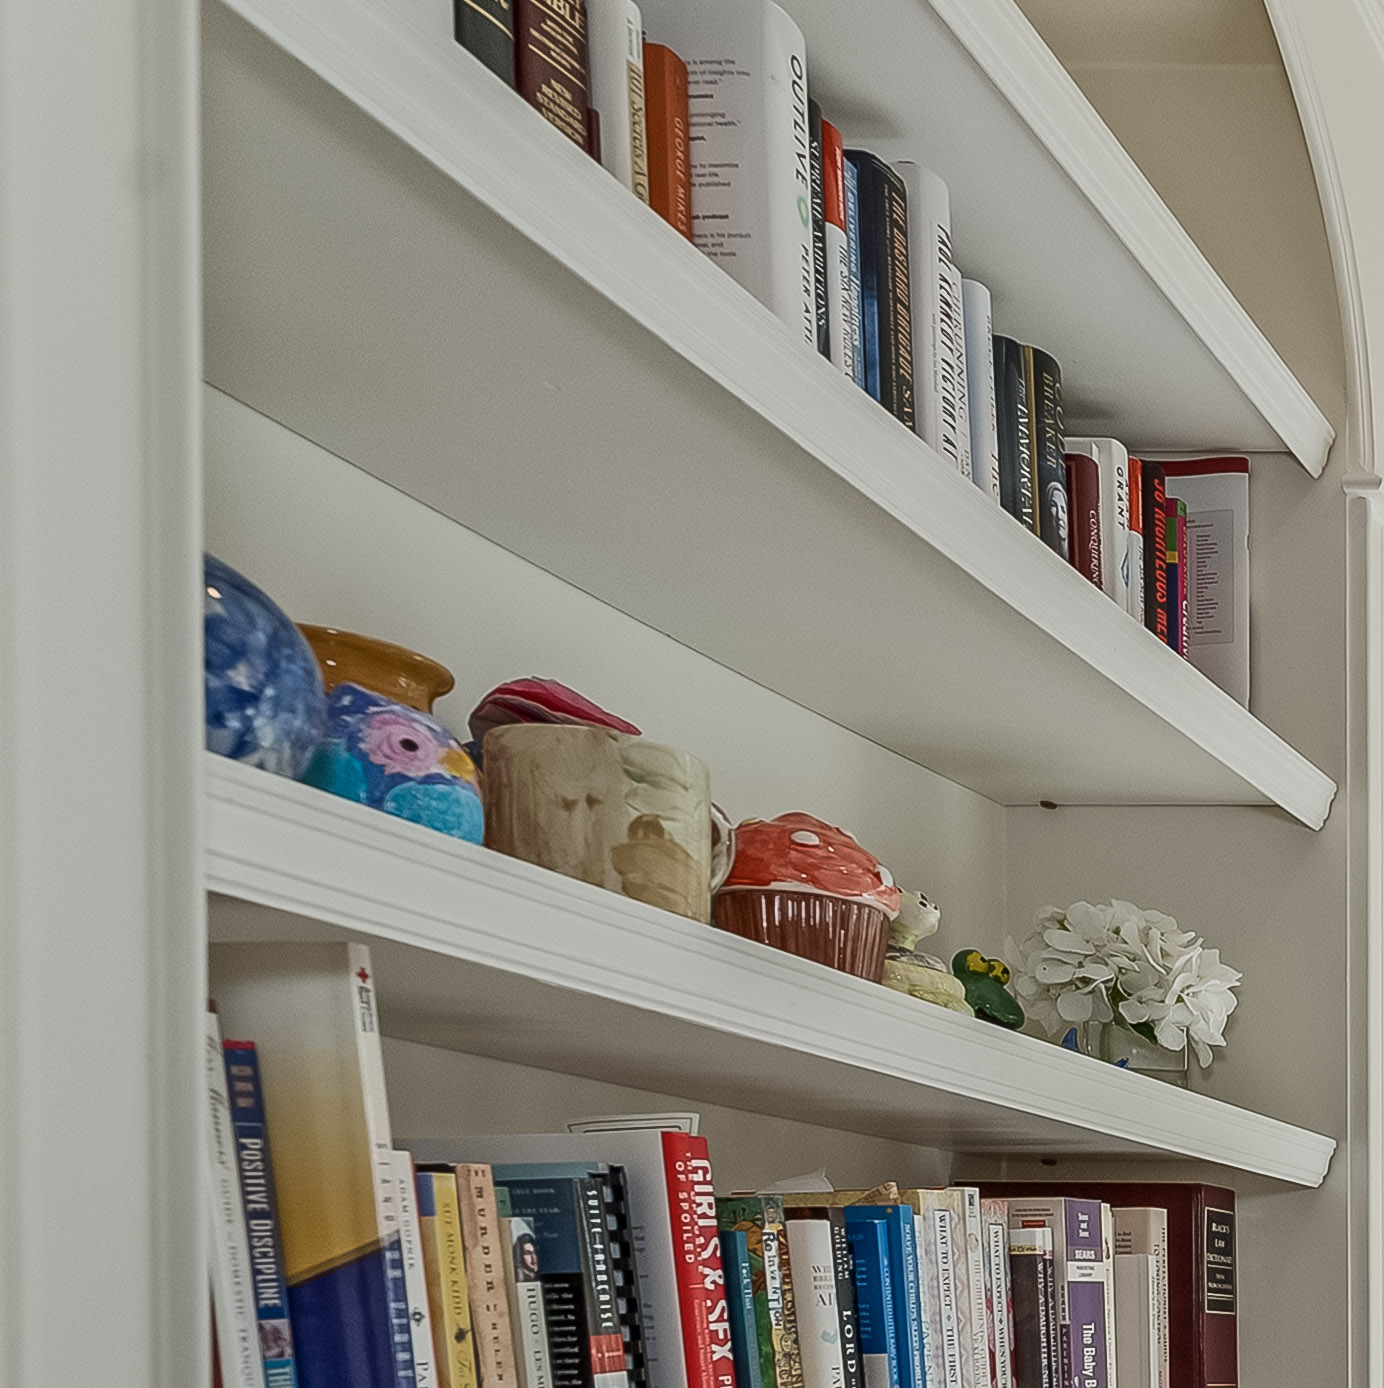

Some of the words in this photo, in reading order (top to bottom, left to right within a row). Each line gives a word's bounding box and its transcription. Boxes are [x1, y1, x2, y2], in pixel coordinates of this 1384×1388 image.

[673, 117, 684, 180] GEORGE
[789, 53, 808, 192] OUTLIVE
[810, 138, 823, 220] SUPREME
[813, 225, 827, 328] AMBITIONS
[937, 224, 952, 273] PAUL
[939, 273, 955, 353] KENNEDY
[941, 357, 957, 433] VICTORY
[1043, 371, 1057, 469] BREAKER
[1116, 465, 1125, 532] GRANT
[238, 1137, 270, 1212] POSITIVE
[675, 1161, 687, 1182] OF
[678, 1191, 696, 1264] SPOILED
[690, 1159, 721, 1258] GIRLS
[937, 1213, 948, 1252] WHAT
[250, 1219, 281, 1308] DISCIPLINE
[703, 1267, 725, 1291] &
[940, 1253, 949, 1265] TO
[1074, 1249, 1096, 1261] SEARS
[942, 1270, 954, 1310] EXPECT
[706, 1299, 734, 1361] SEX
[946, 1326, 956, 1350] THE
[1081, 1322, 1095, 1345] The
[948, 1351, 958, 1386] FIRST
[1083, 1347, 1098, 1378] Baby
